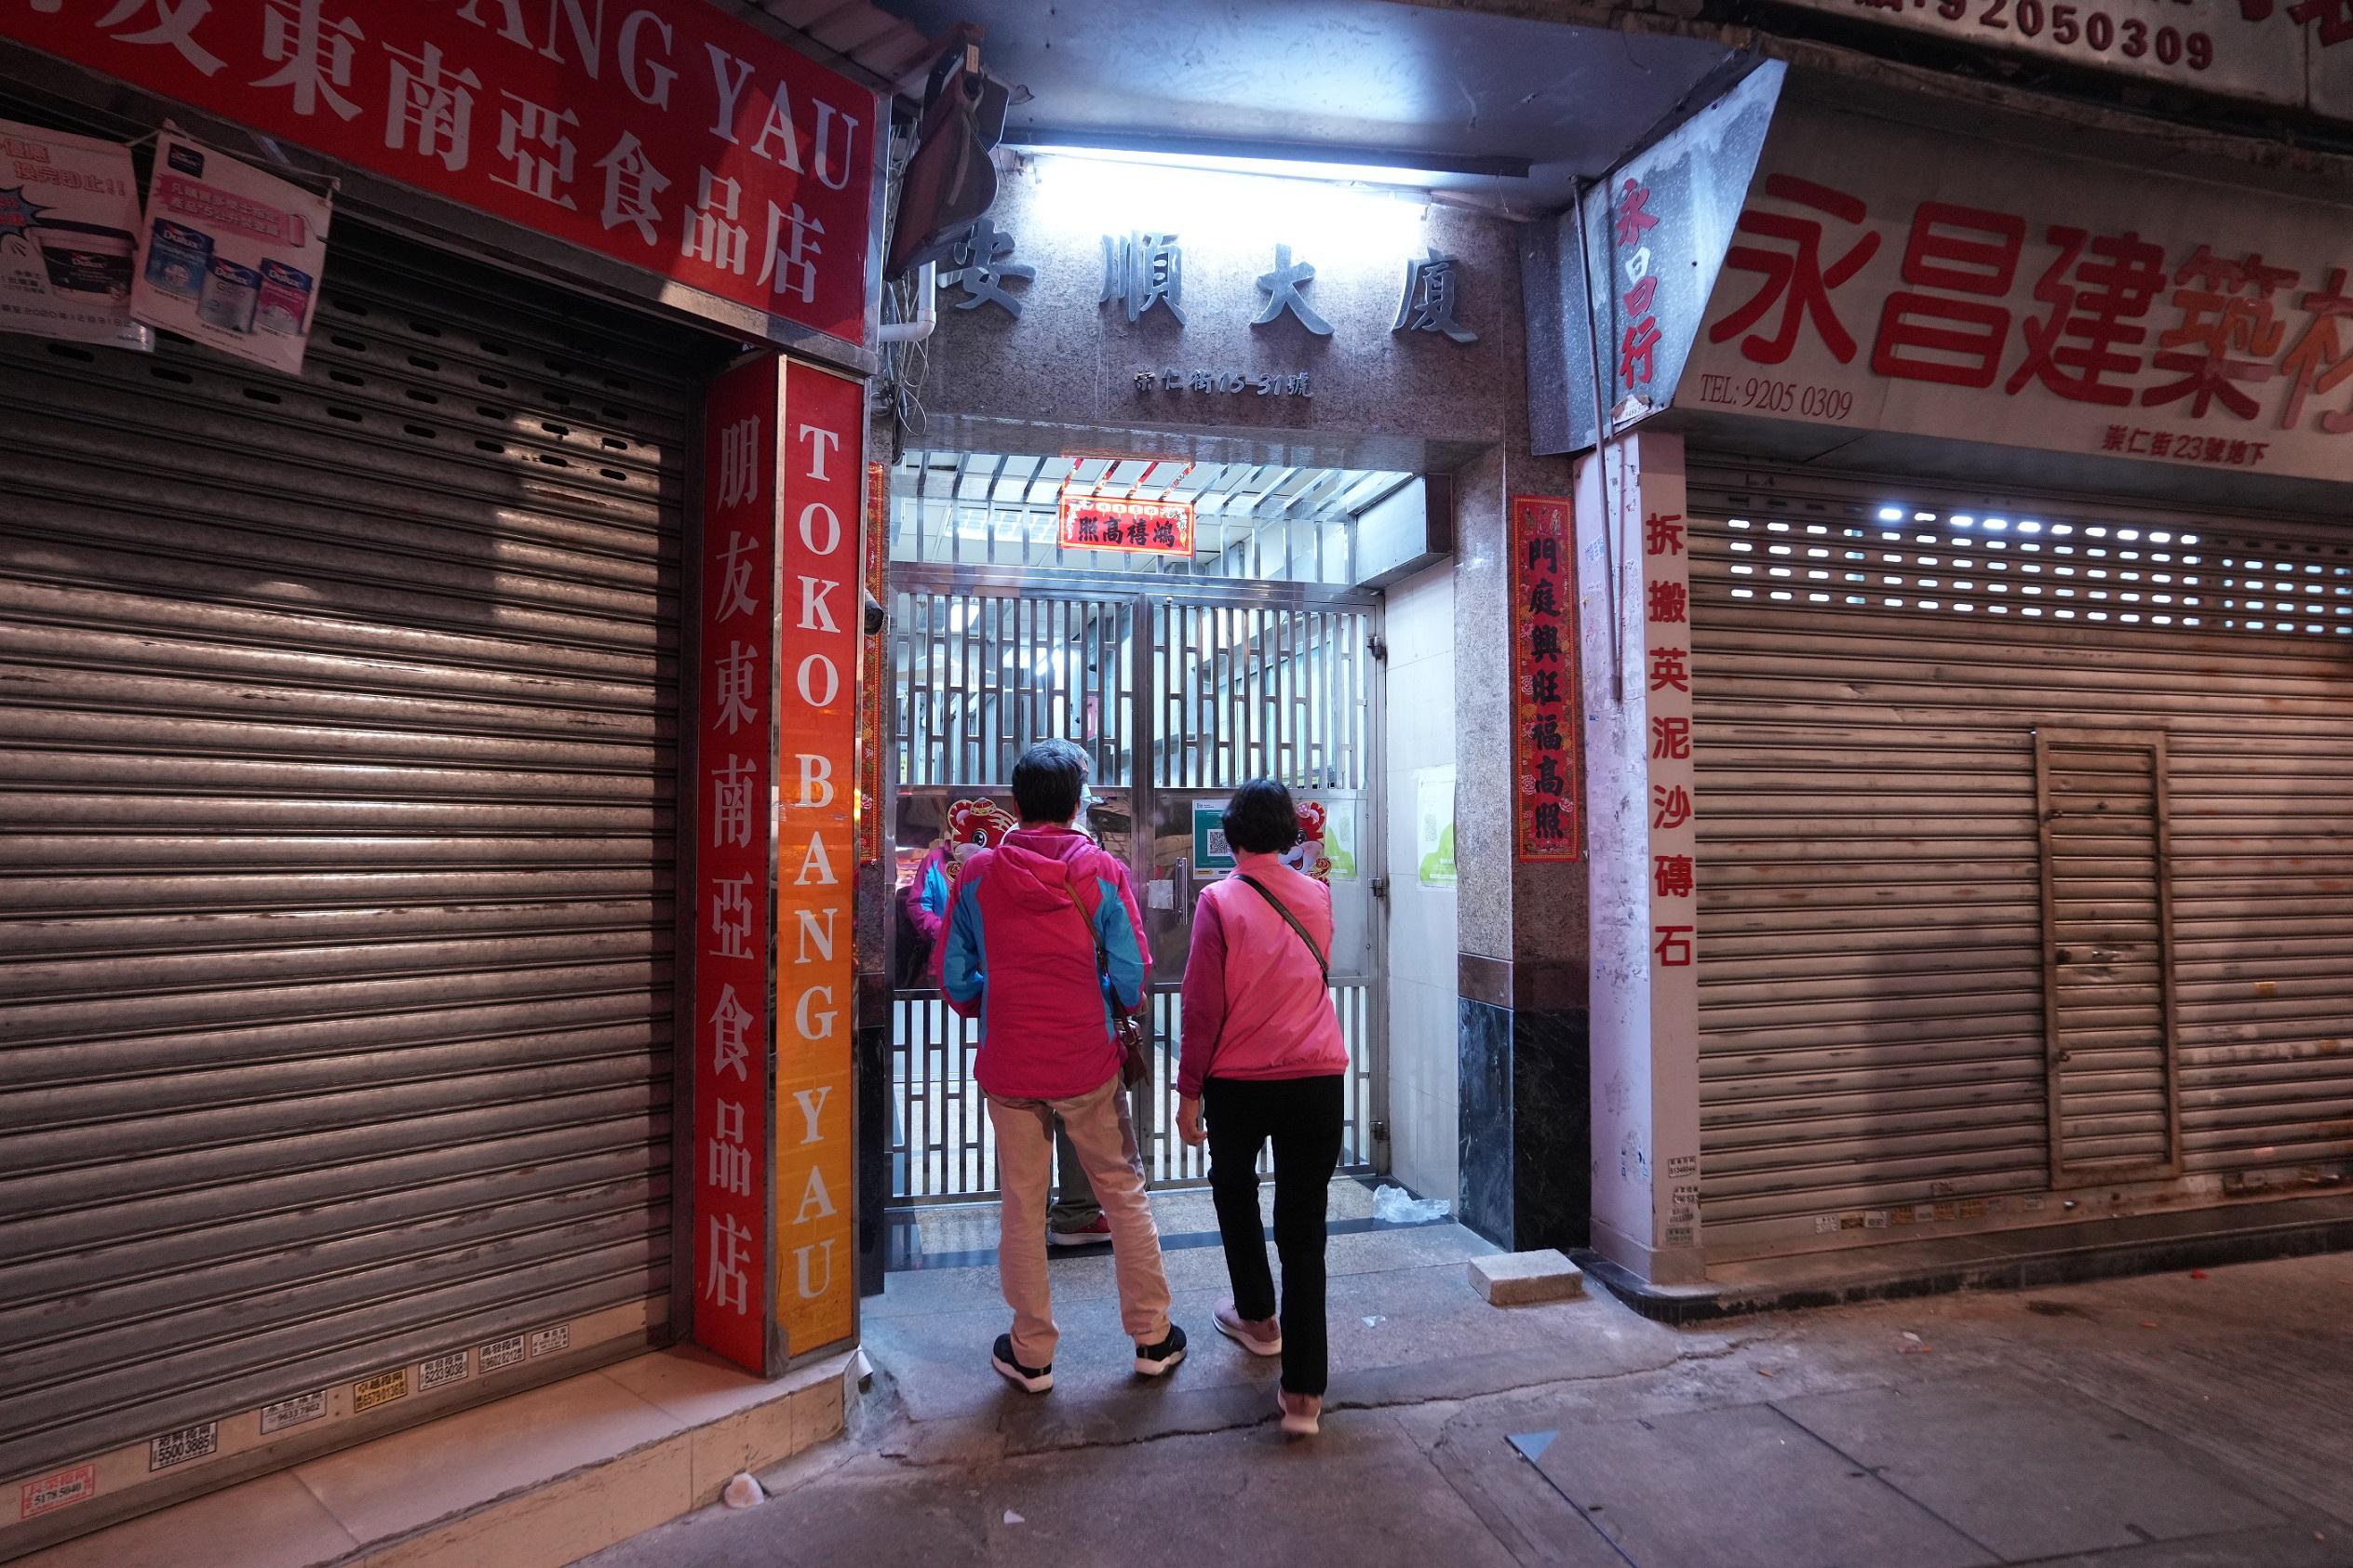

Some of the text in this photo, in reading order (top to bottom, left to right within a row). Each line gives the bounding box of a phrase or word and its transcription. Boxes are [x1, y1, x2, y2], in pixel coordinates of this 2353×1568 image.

[30, 0, 826, 302] 友東南亞食品店
[705, 42, 859, 190] YAU
[215, 266, 247, 285] Dulux
[934, 218, 1479, 343] 安順大廈
[1701, 374, 1852, 420] TEL: 9205 0309
[2101, 424, 2270, 467] 崇仁街23號地下
[1526, 537, 1564, 839] 門庭興旺福高照
[1646, 513, 1695, 967] 拆搬英泥沙磚石
[706, 414, 761, 1315] 朋友東南亞食品店
[791, 423, 842, 1301] TOKO BANG YAU
[157, 1441, 186, 1462] 5500
[184, 1434, 211, 1454] 3885
